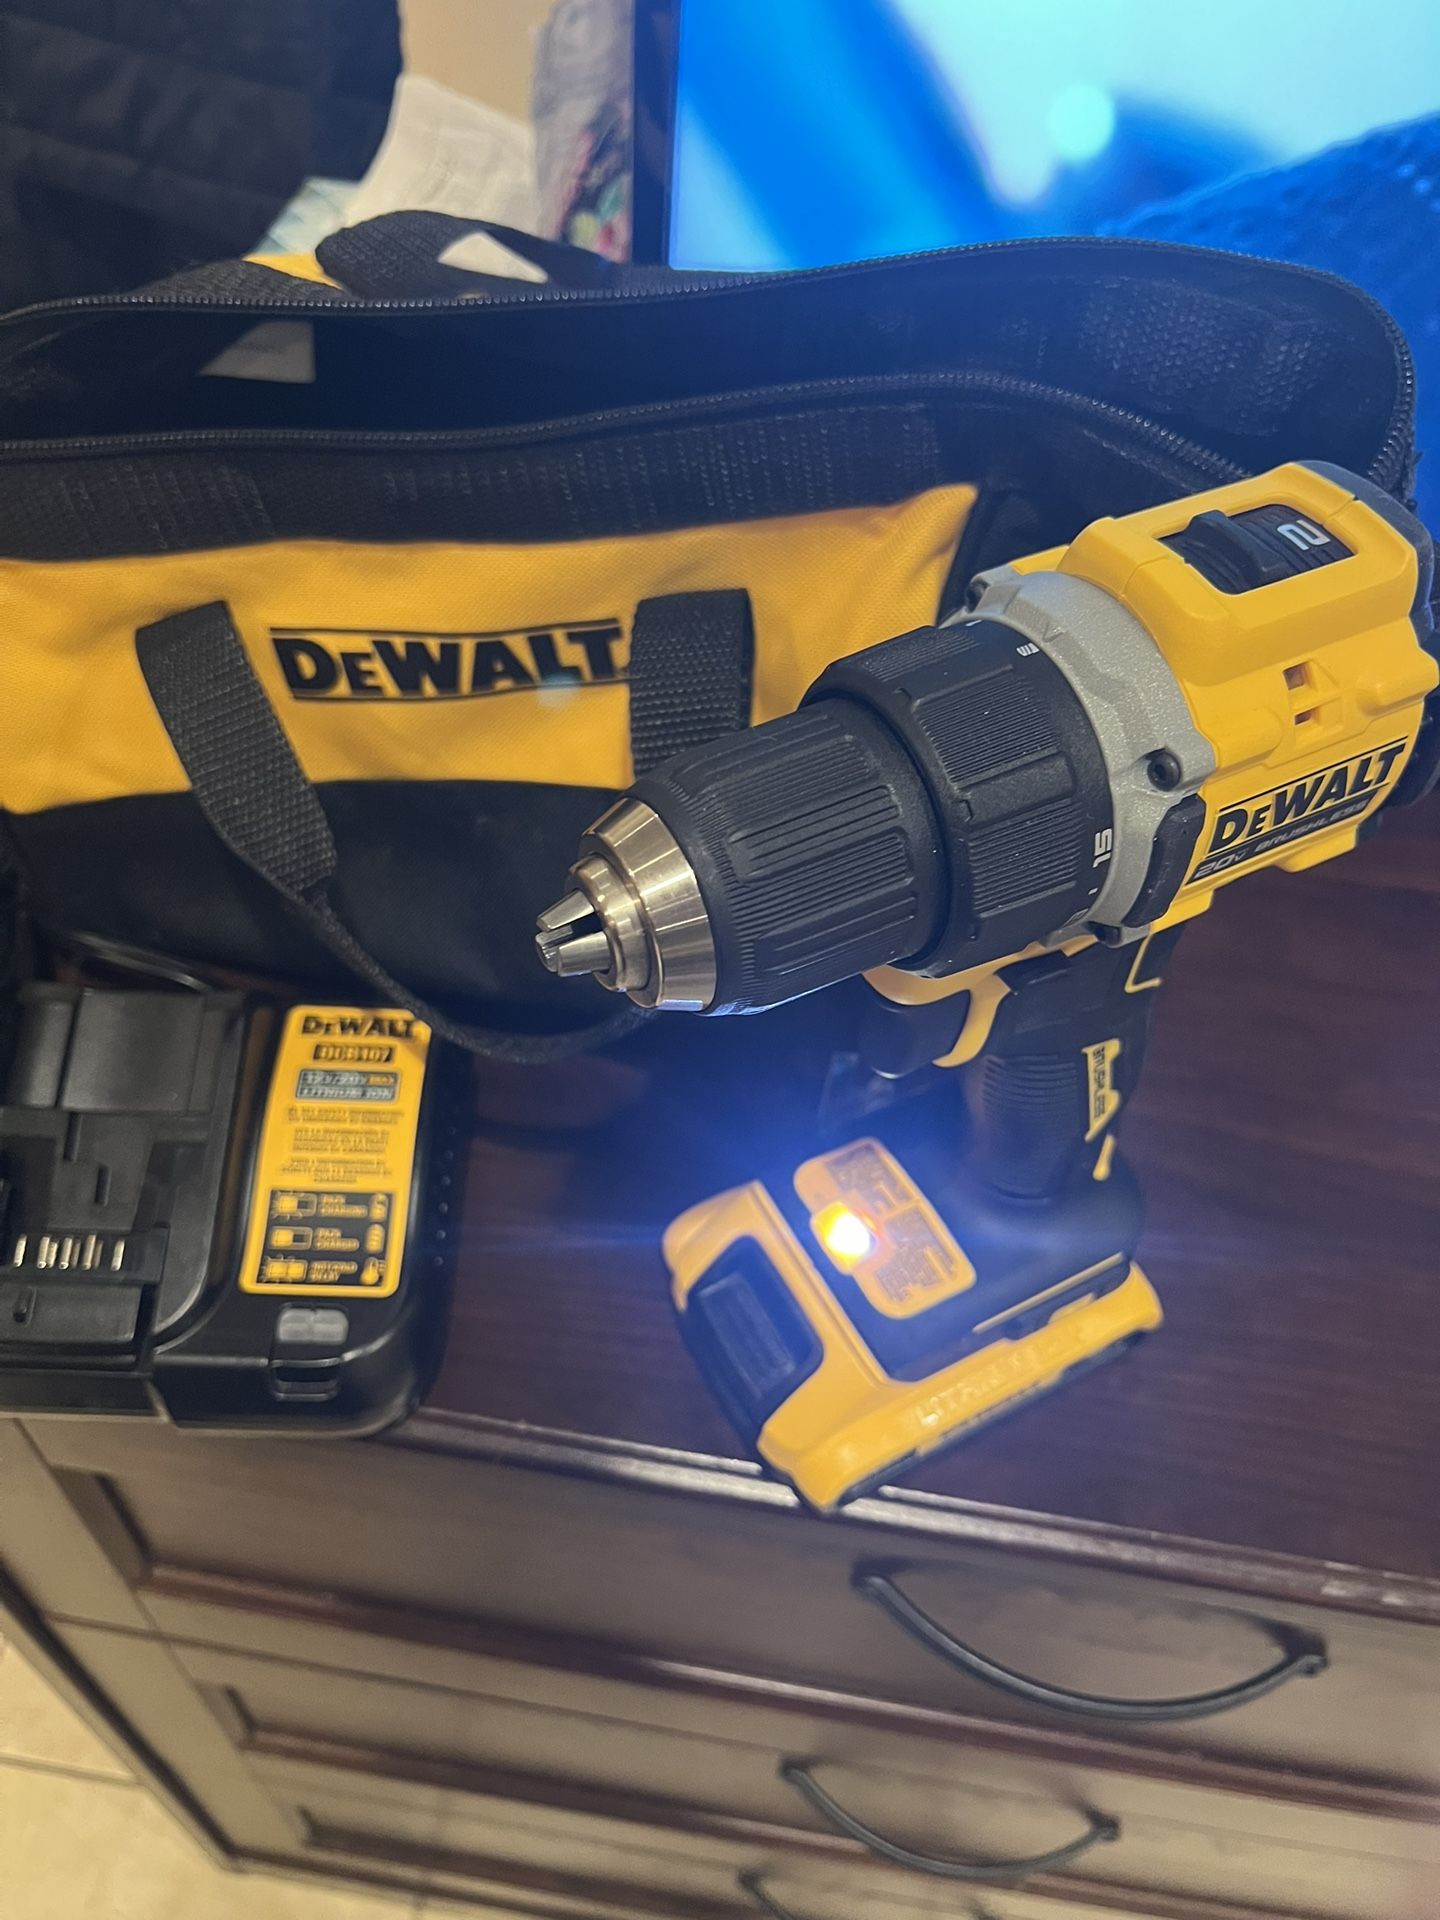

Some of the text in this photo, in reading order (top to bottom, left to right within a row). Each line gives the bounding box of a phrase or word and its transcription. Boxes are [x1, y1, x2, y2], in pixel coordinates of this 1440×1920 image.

[1277, 519, 1331, 551] 2
[271, 625, 623, 696] DEWALT
[1207, 743, 1407, 856] DEWALT
[1092, 828, 1112, 869] 15
[301, 1014, 417, 1039] DEWALT
